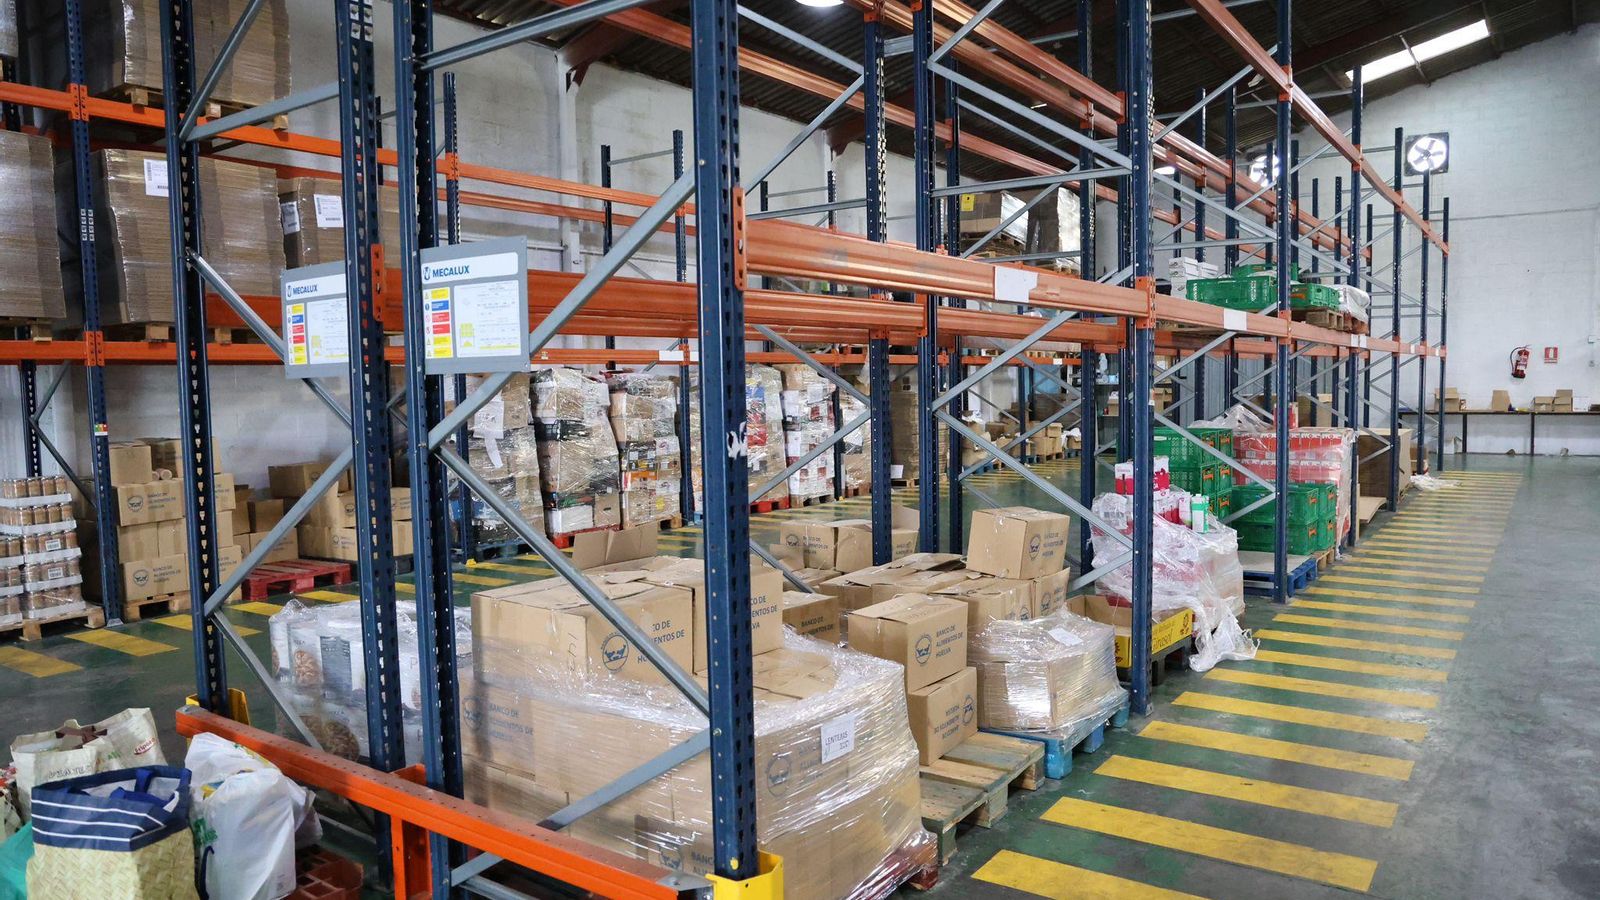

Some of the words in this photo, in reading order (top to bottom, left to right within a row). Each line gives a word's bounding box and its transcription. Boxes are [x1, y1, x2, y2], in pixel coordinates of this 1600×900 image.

[432, 265, 470, 278] MECALUX
[292, 284, 318, 295] MECALUX
[759, 595, 766, 603] DE
[751, 605, 770, 618] ENTOS
[770, 604, 778, 613] DE
[661, 619, 671, 630] DE
[936, 626, 950, 638] BANCO
[950, 624, 956, 632] DE
[652, 631, 675, 645] ENTOS
[675, 629, 685, 640] DE
[691, 851, 714, 865] BANC
